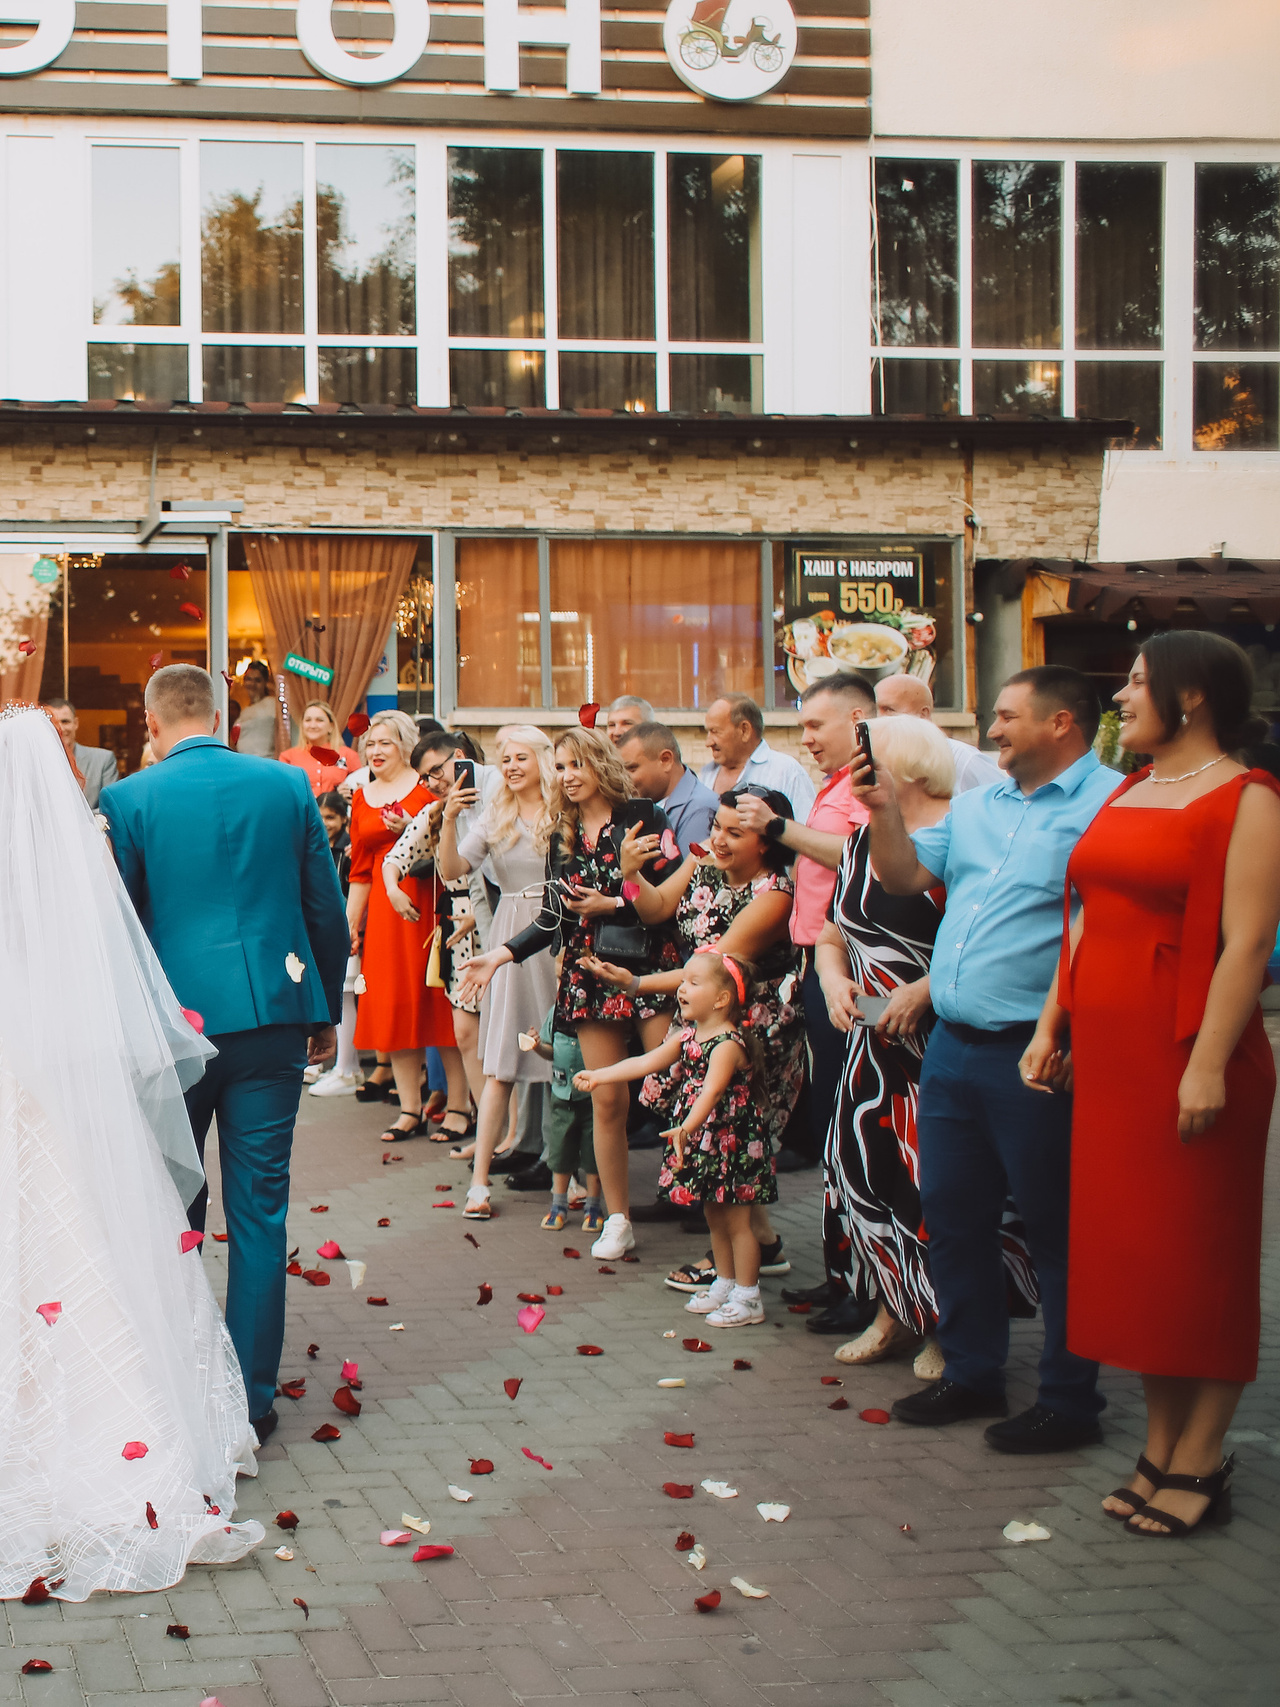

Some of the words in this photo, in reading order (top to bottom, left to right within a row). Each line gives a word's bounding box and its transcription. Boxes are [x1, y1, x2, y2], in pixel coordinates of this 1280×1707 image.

[803, 560, 835, 577] ХАШ
[837, 560, 848, 577] С
[850, 560, 914, 578] НАБОРОМ
[288, 657, 330, 681] ОТКРЫТО
